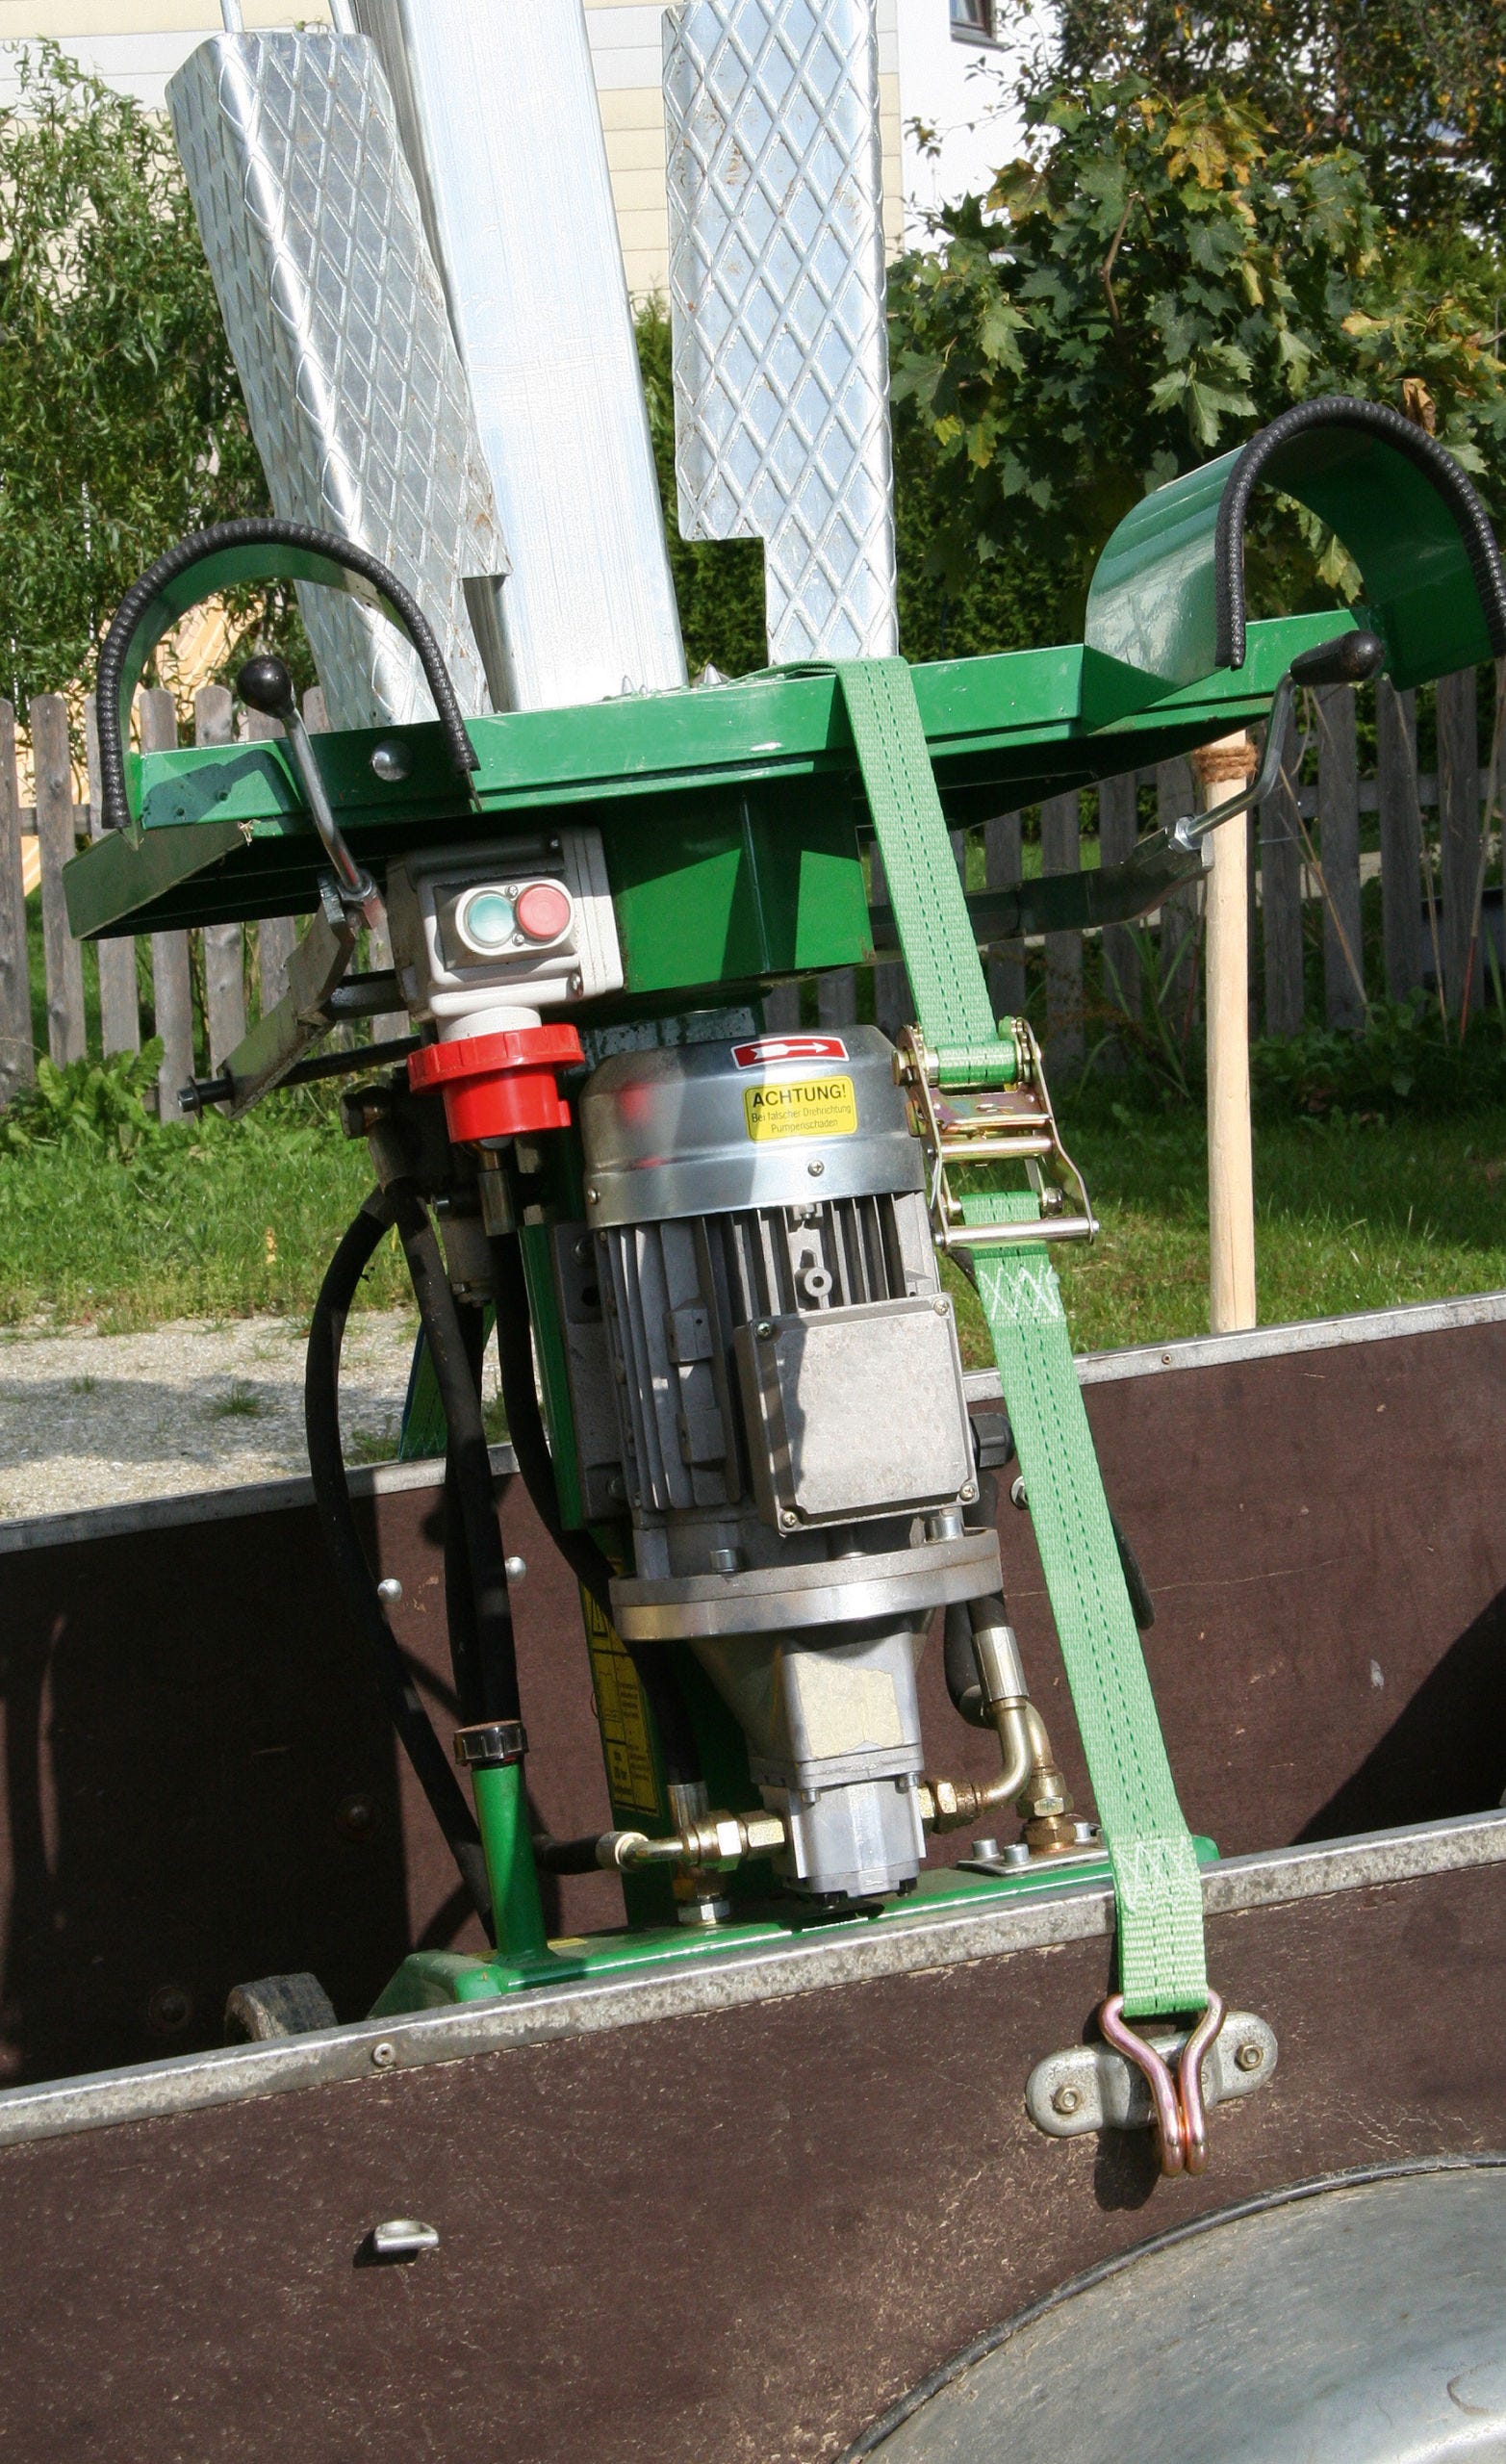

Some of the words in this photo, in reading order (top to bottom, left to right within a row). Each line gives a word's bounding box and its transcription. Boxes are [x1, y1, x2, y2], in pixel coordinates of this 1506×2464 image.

[753, 1084, 847, 1108] ACHTUNG!
[752, 1113, 766, 1123] Bei
[768, 1109, 801, 1121] falscher
[803, 1105, 852, 1117] Drehrichtung
